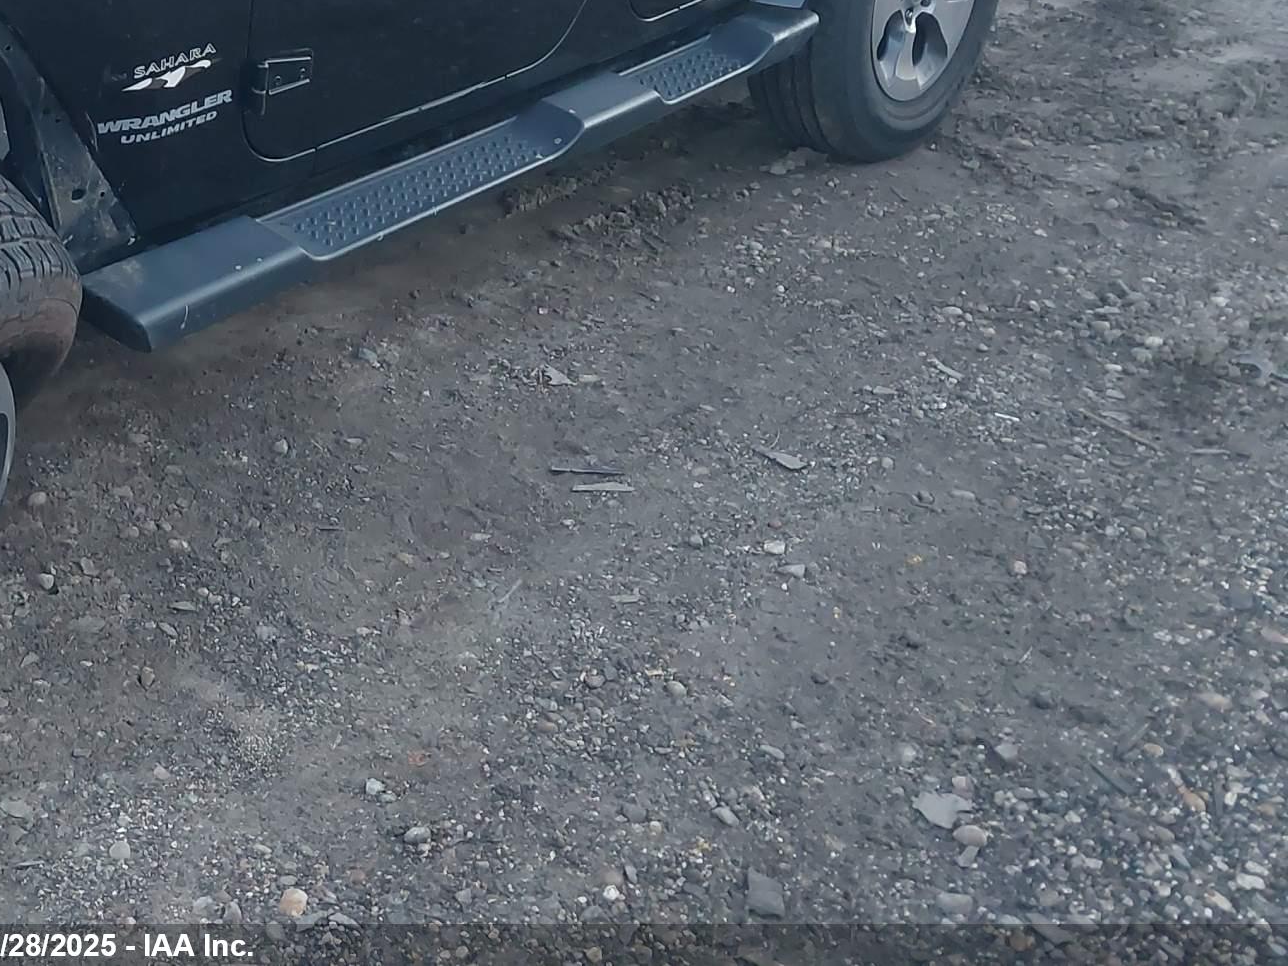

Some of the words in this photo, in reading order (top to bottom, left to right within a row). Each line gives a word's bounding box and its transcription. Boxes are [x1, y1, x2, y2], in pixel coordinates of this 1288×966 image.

[133, 43, 216, 79] SAHARA
[97, 90, 233, 134] WRANGLER
[120, 110, 218, 145] UNLIMITED
